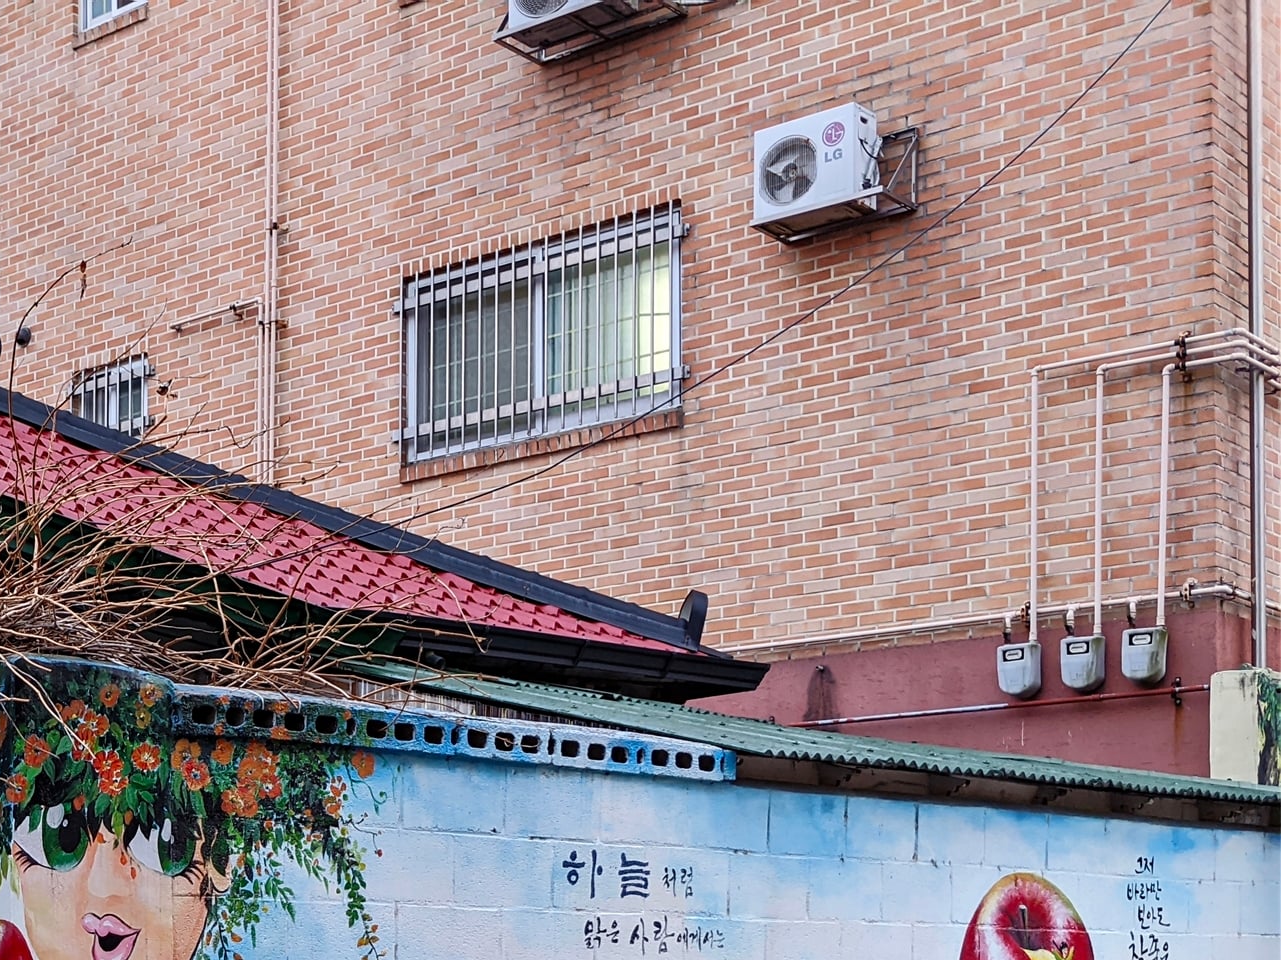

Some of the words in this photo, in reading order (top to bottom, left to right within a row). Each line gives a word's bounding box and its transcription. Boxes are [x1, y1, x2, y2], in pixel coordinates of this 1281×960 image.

[824, 147, 843, 163] LG
[1134, 855, 1155, 875] 그저
[1126, 879, 1162, 901] 바라만
[1137, 902, 1171, 930] 보아도
[583, 916, 620, 950] 맑은
